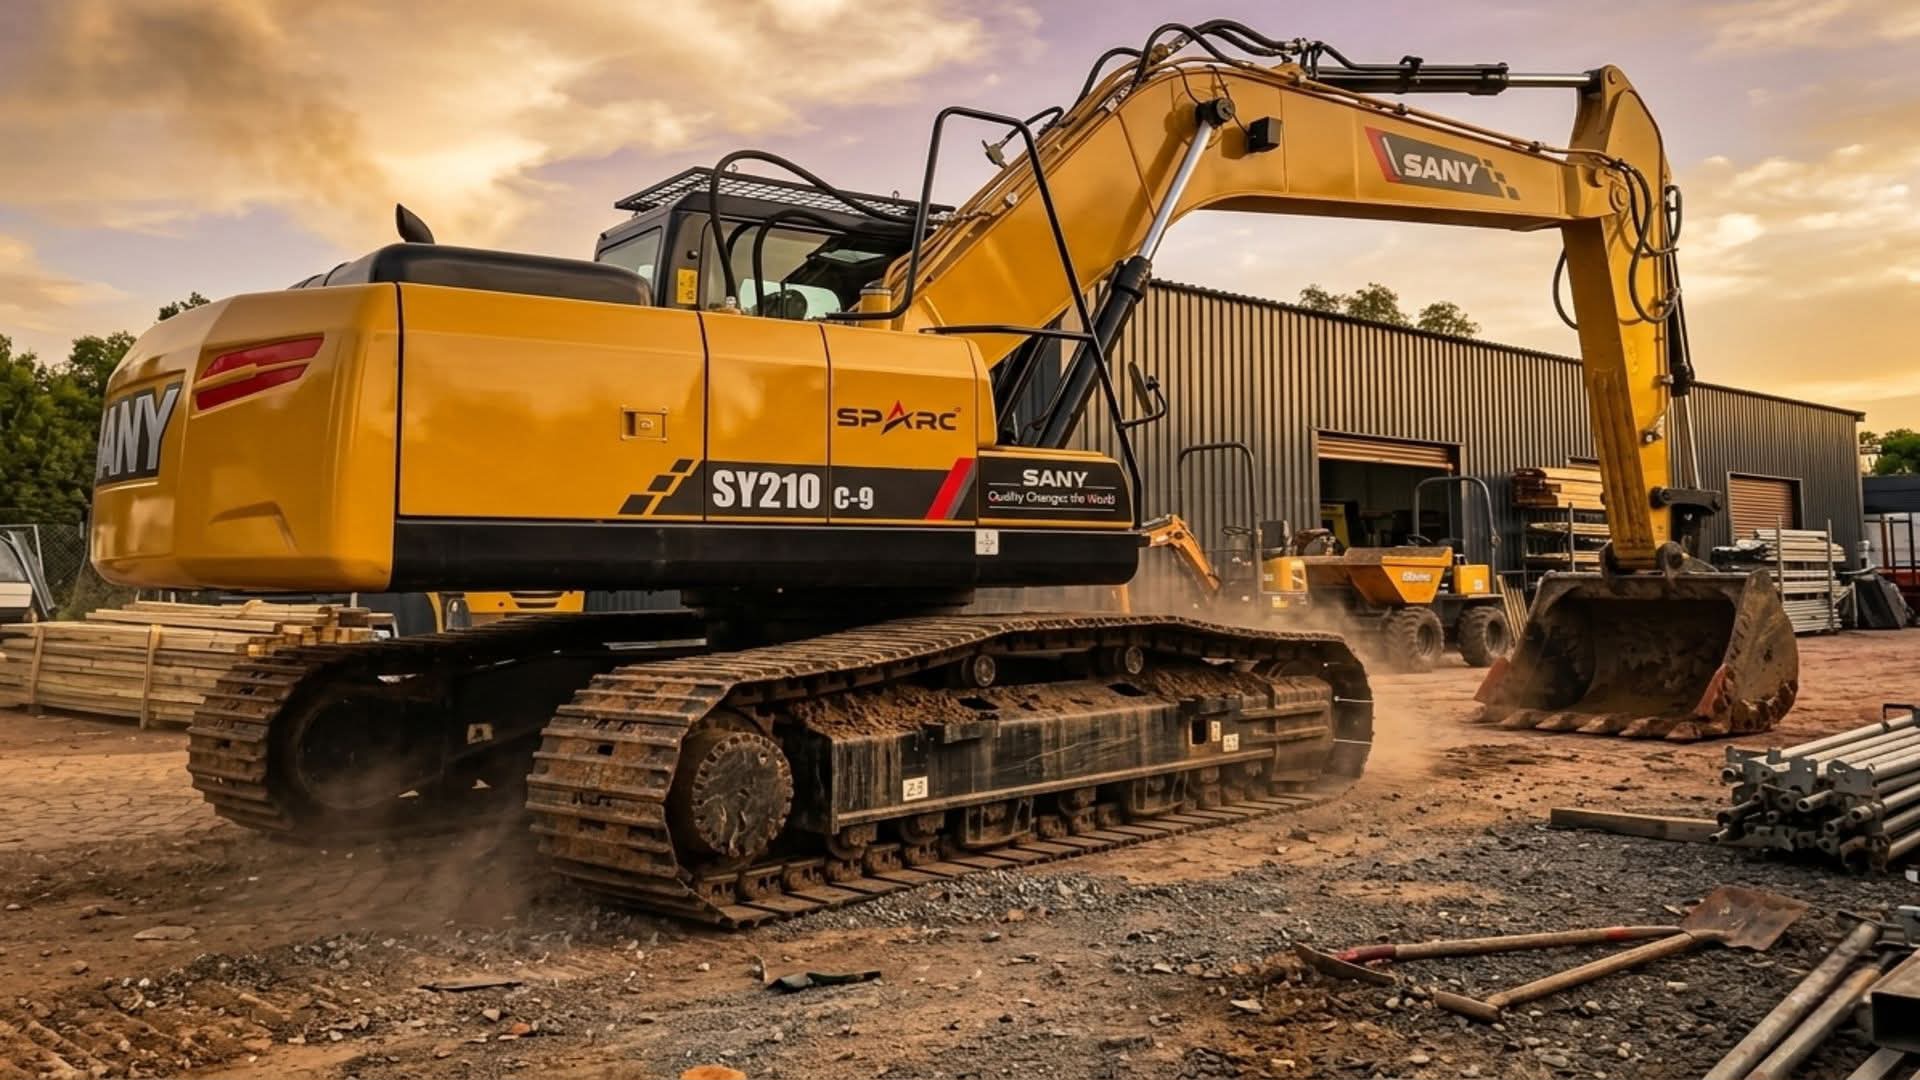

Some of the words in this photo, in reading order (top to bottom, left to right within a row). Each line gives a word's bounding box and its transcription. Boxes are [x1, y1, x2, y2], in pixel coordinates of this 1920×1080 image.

[1403, 153, 1478, 185] SANY
[96, 388, 179, 479] ANY
[836, 400, 957, 435] SPARC
[712, 469, 821, 510] SY210
[834, 486, 874, 510] C-9
[1022, 469, 1089, 488] SANY
